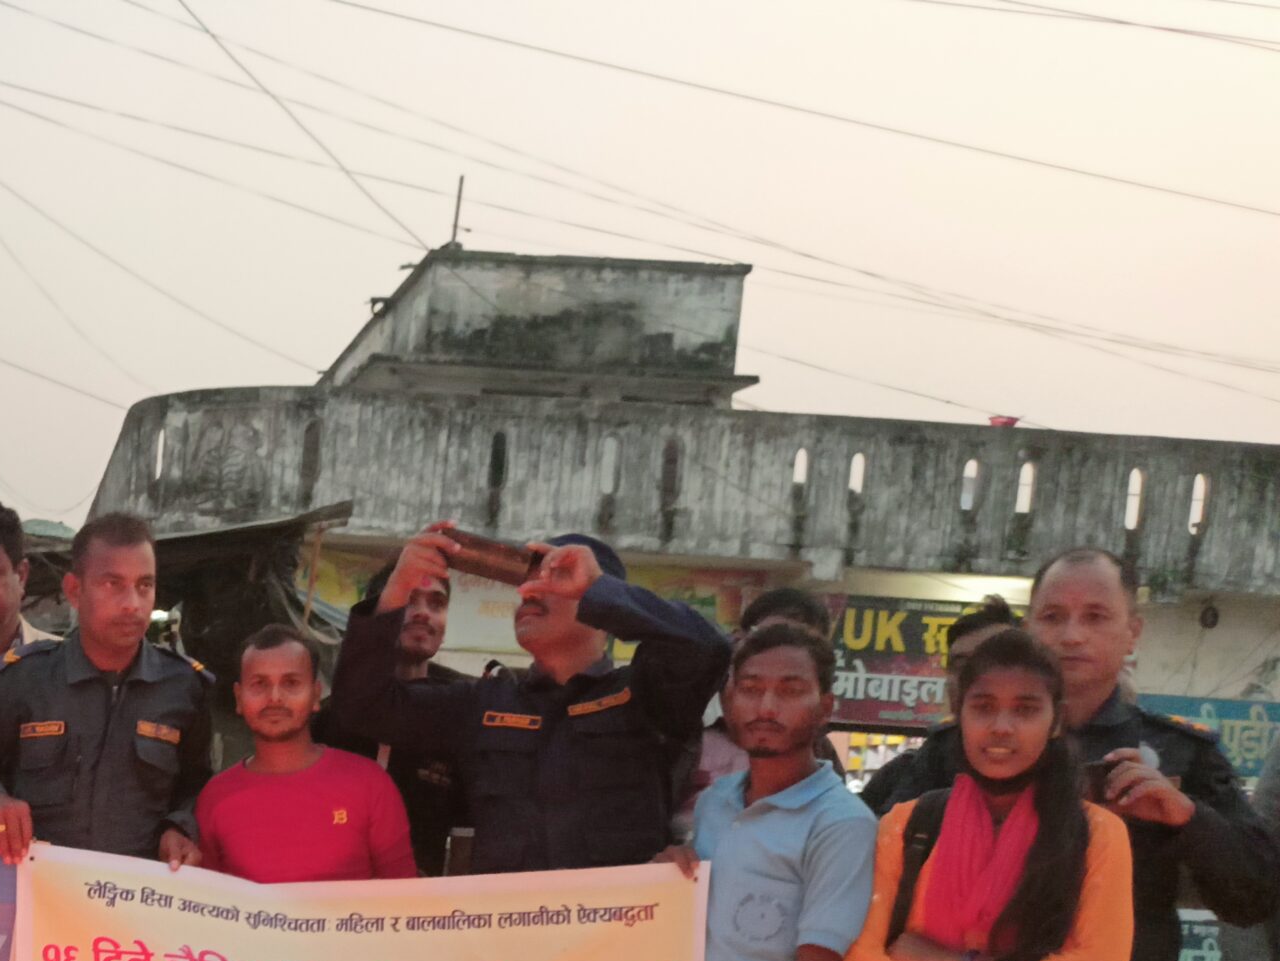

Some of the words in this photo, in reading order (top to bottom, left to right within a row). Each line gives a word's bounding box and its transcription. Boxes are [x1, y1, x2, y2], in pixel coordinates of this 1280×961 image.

[843, 607, 906, 653] UK
[335, 912, 385, 934] महिला
[389, 916, 402, 933] र
[497, 904, 572, 930] लगानीको
